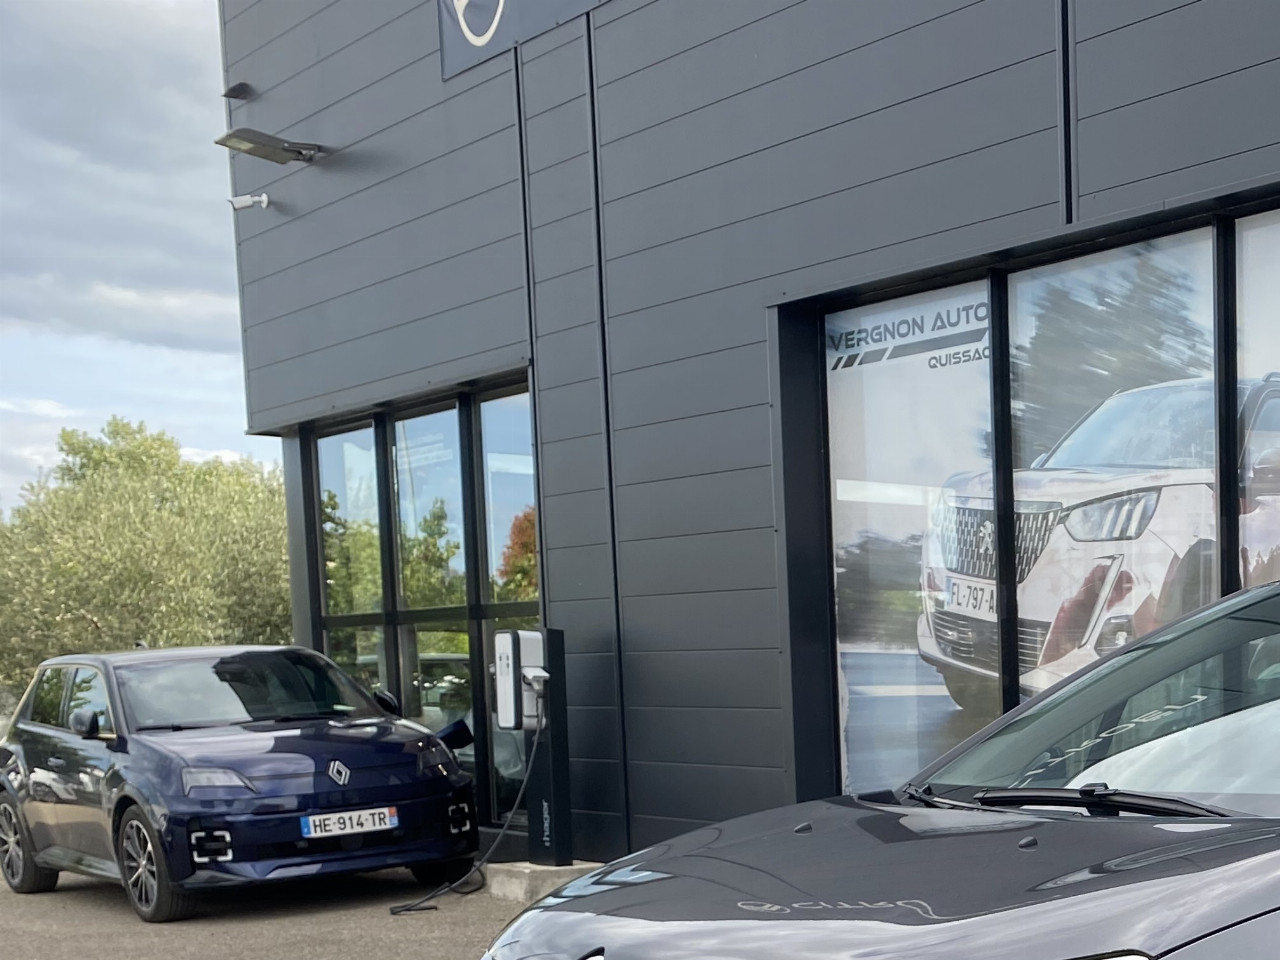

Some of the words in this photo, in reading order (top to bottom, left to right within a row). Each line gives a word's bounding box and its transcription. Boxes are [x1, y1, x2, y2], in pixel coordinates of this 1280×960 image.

[830, 315, 924, 352] VERGNON
[931, 301, 989, 332] AUTO
[951, 582, 995, 613] FL-797-A
[313, 811, 387, 834] HE-914-TR
